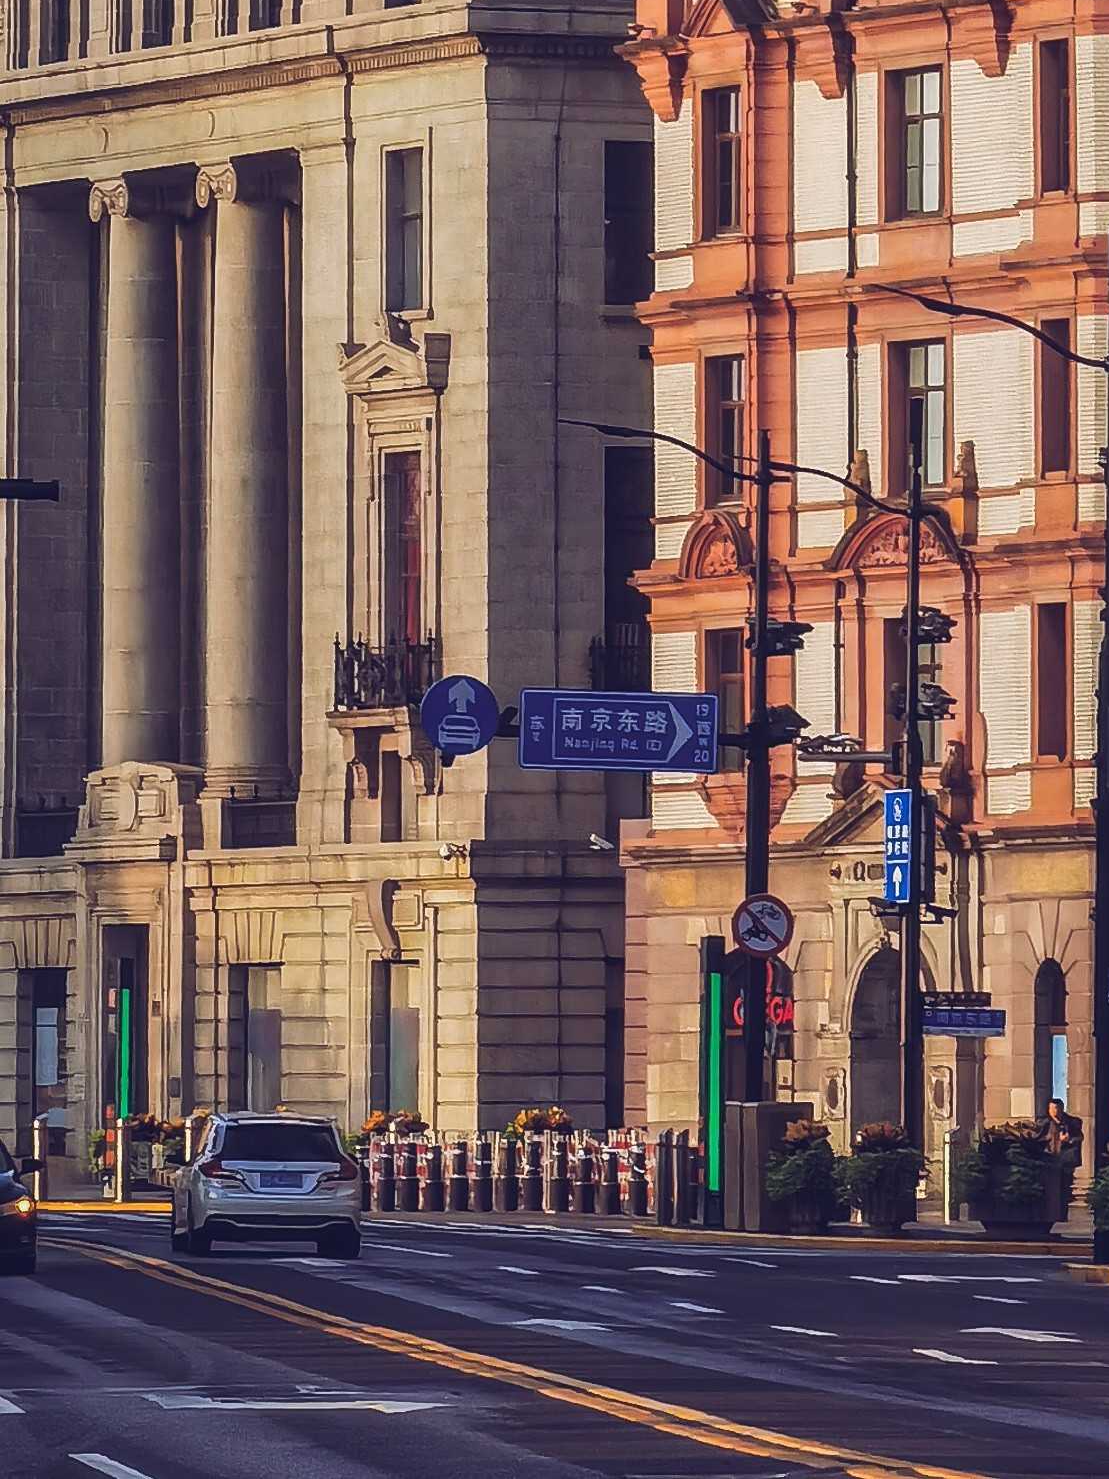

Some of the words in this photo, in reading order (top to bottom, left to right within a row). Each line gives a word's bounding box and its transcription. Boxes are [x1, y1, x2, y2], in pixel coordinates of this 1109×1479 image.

[696, 704, 710, 717] 19
[560, 707, 668, 735] 南京东路
[564, 737, 615, 752] Nanjing
[694, 749, 709, 763] 20
[733, 996, 794, 1026] OGA
